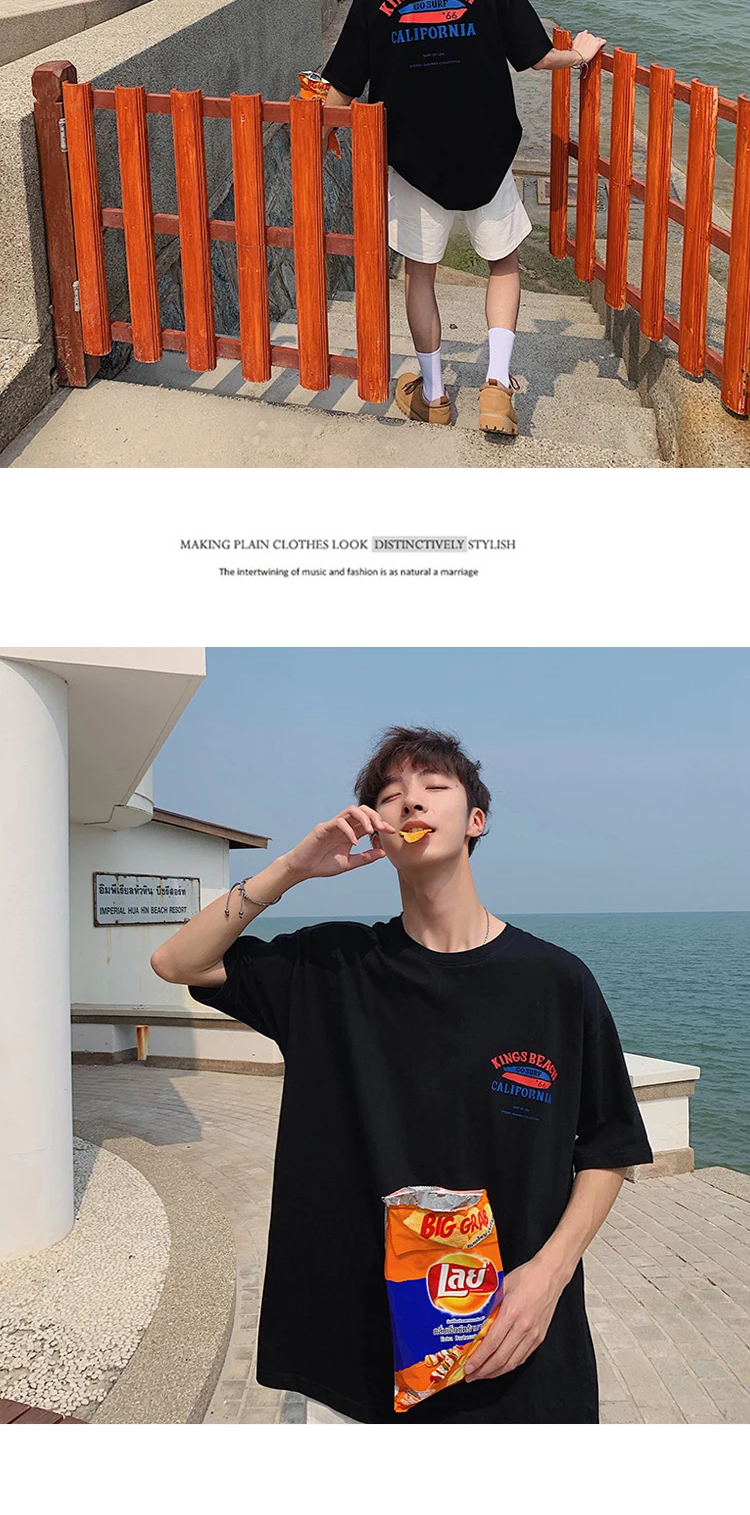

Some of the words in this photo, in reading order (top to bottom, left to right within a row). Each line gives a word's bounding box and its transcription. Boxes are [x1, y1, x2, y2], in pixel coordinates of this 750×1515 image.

[413, 2, 426, 10] GO
[426, 0, 448, 8] SURF
[391, 23, 476, 44] CALIFORNIA
[491, 1051, 528, 1070] KINGS
[528, 1052, 558, 1081] BEACH
[525, 1068, 542, 1076] SURF
[420, 1212, 456, 1239] BIG
[460, 1209, 488, 1235] GRAB
